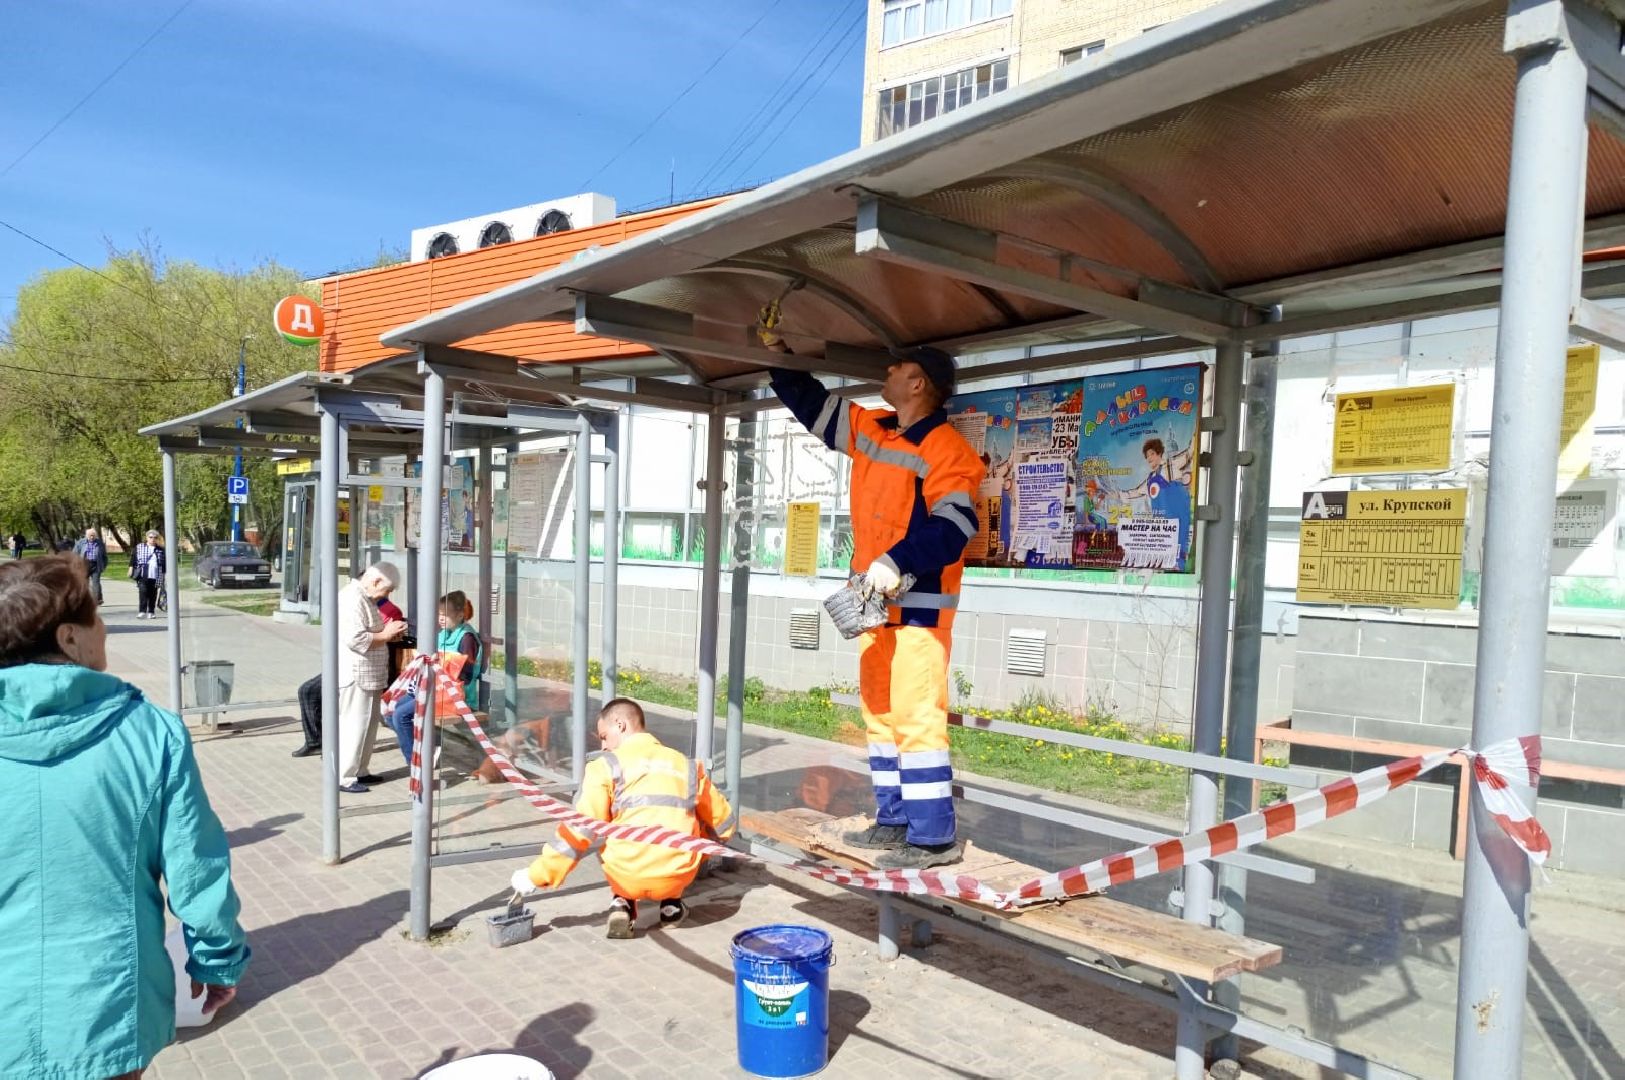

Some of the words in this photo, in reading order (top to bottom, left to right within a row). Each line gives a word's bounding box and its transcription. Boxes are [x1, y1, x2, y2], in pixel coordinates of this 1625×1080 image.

[291, 303, 315, 333] Д
[1018, 463, 1064, 475] СТРОИТЕЛЬСТВО
[233, 479, 245, 493] P
[1359, 502, 1379, 514] ул.
[1383, 498, 1452, 514] Крупской
[1120, 524, 1150, 532] МАСТЕР
[1030, 555, 1041, 565] +7
